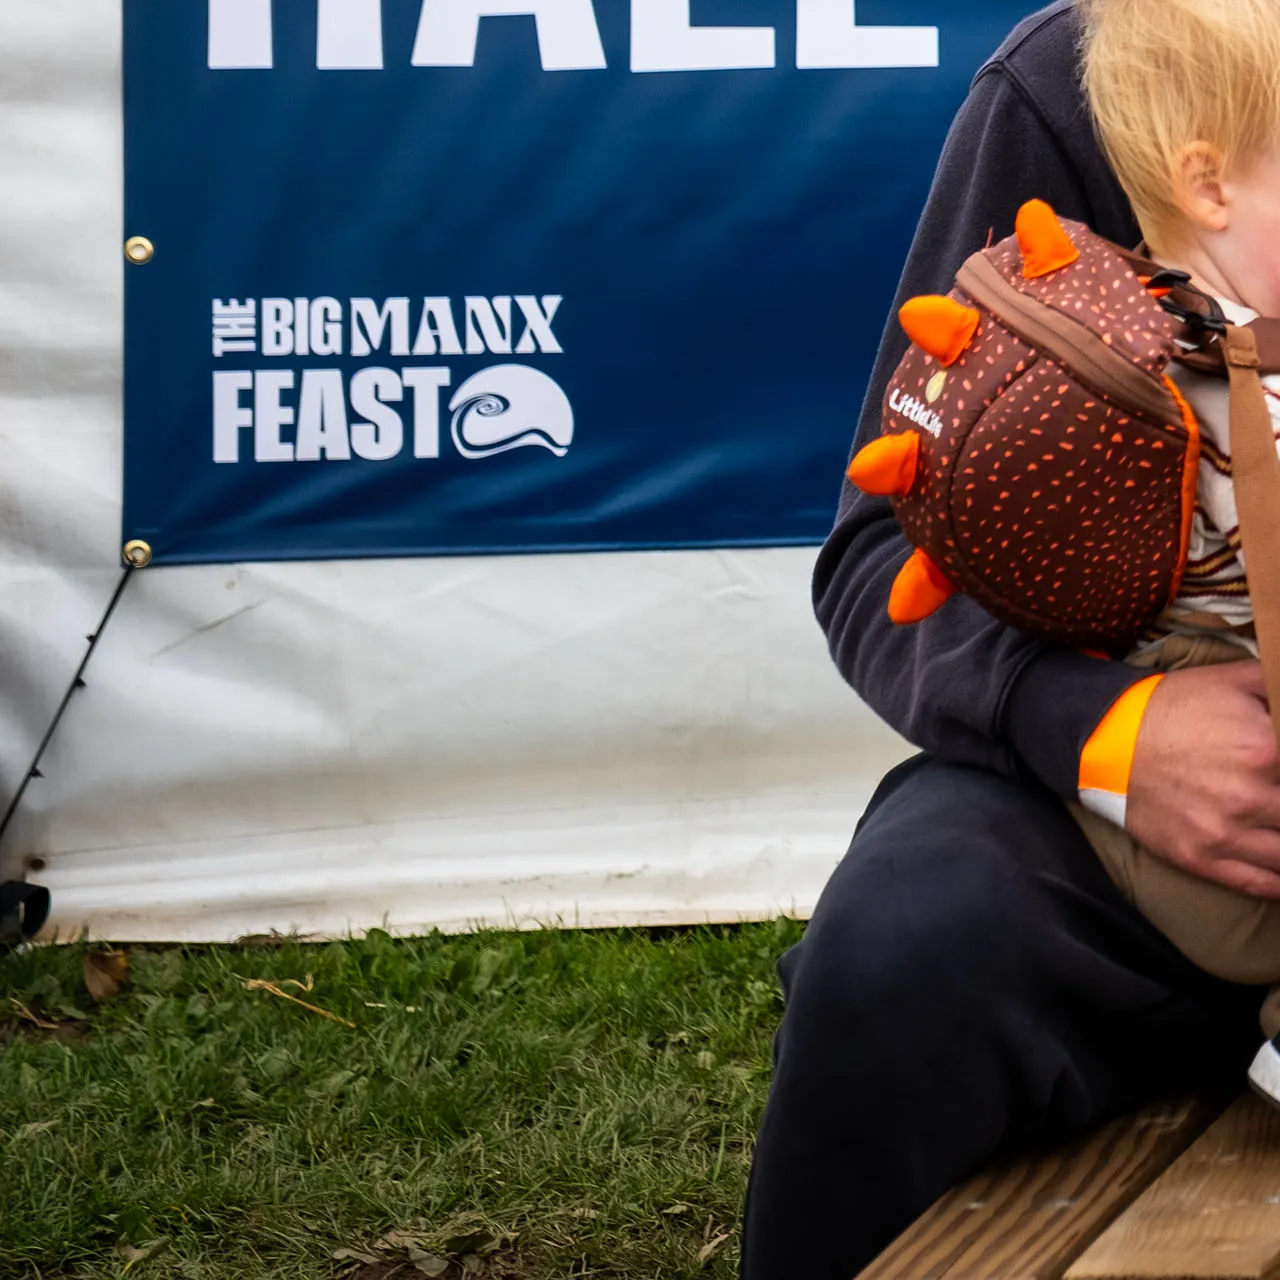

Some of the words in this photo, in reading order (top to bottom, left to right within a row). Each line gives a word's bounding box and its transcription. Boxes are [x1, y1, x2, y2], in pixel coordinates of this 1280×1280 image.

[212, 297, 257, 358] THE
[261, 296, 343, 356] BIG
[349, 295, 564, 357] MANX
[212, 365, 452, 464] FEAST
